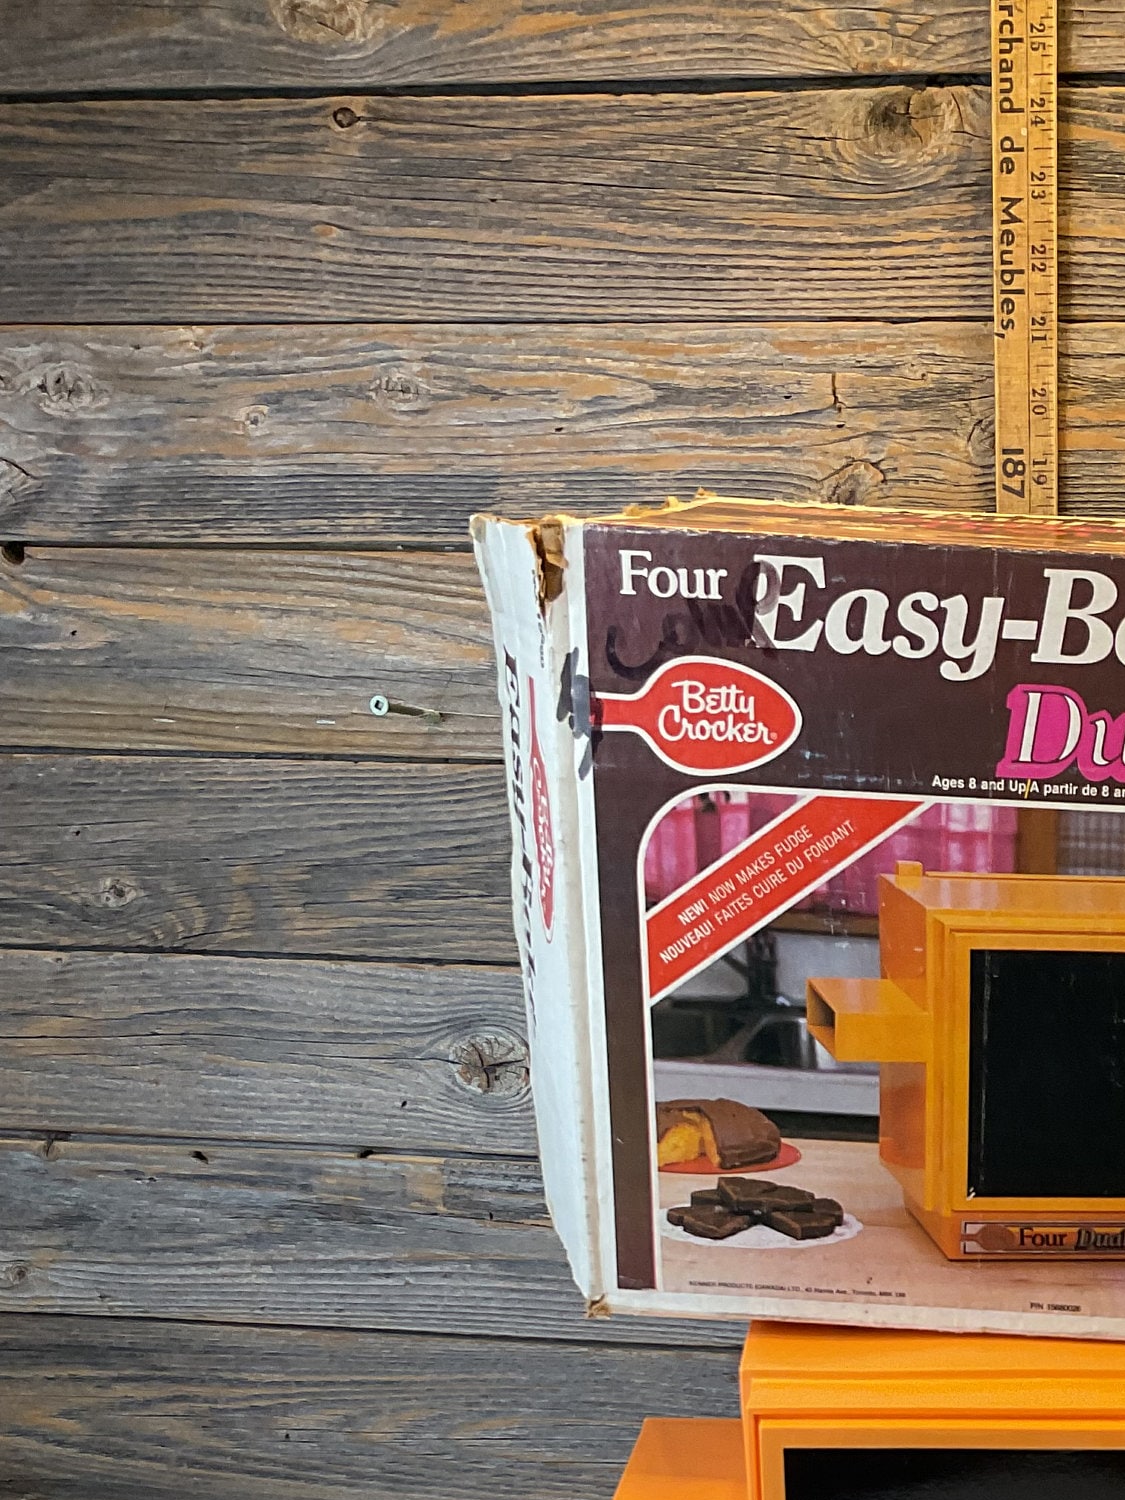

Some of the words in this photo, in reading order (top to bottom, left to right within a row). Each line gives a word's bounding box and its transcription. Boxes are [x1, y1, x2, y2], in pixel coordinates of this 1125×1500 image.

[999, 0, 1025, 113] rchand
[999, 136, 1025, 174] de
[994, 197, 1026, 339] Meubles,
[1001, 449, 1026, 499] 187
[619, 550, 728, 600] Four
[658, 703, 773, 746] Crocker
[671, 679, 757, 721] Betty
[932, 775, 964, 790] Ages
[968, 777, 976, 789] 8
[981, 779, 1004, 791] and
[1044, 783, 1078, 797] partir
[1082, 784, 1098, 796] de
[1101, 785, 1109, 797] 8
[659, 921, 716, 964] NOUVEAU!
[714, 893, 753, 926] FAITES
[752, 869, 787, 900] CUIRE
[787, 857, 805, 875] DU
[804, 819, 856, 863] FONDANT
[677, 899, 709, 926] NEW!
[709, 878, 736, 904] NOW
[738, 851, 776, 886] MAKES
[774, 824, 813, 856] FUDGE
[1018, 1227, 1067, 1247] Four
